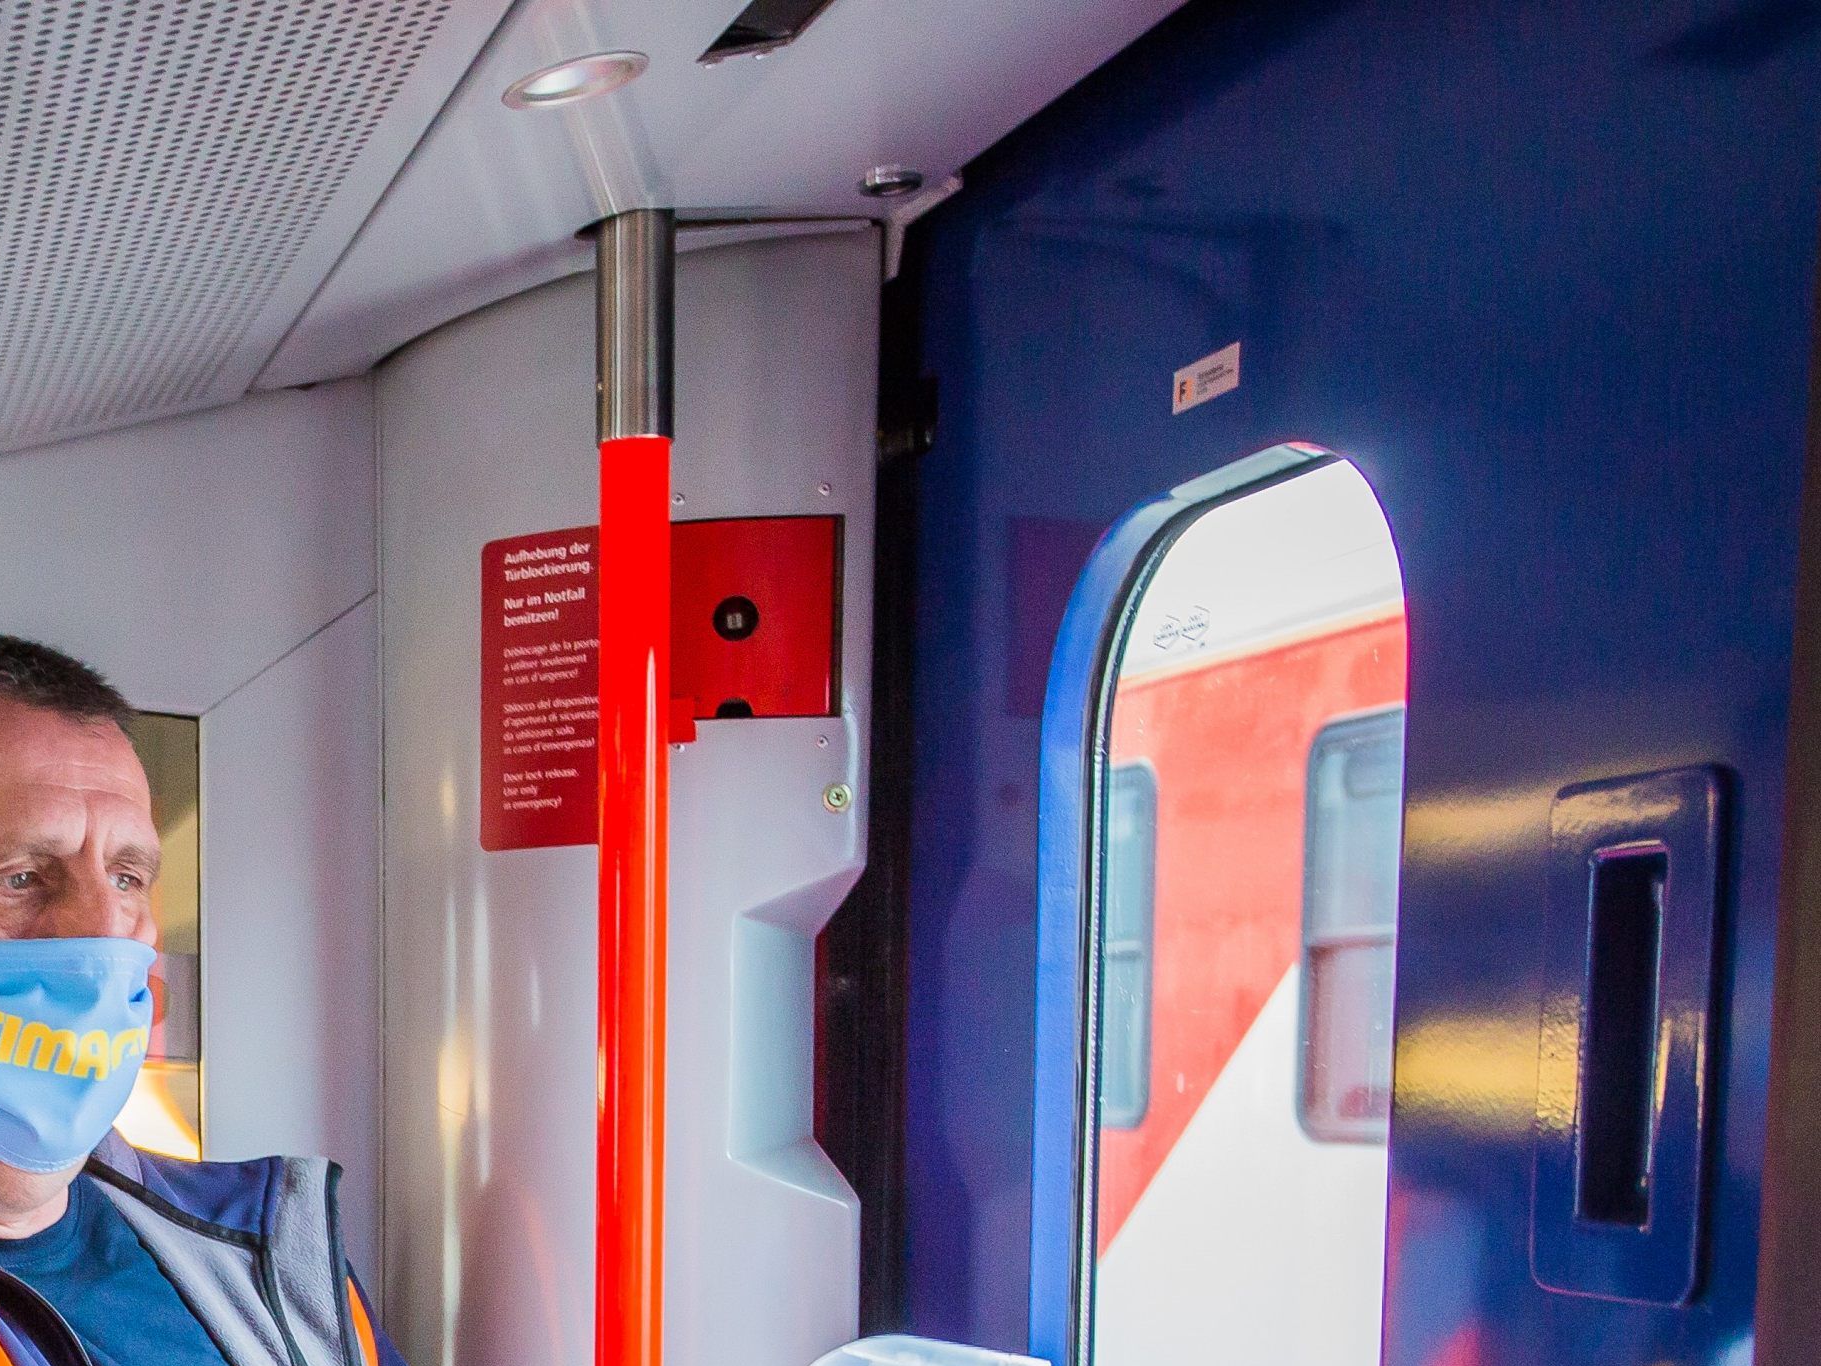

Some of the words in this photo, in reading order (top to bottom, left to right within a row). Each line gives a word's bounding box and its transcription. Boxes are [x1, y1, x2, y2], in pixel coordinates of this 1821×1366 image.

[504, 547, 567, 565] Aufhebung
[569, 542, 591, 555] der
[504, 598, 525, 610] Nur
[526, 594, 542, 607] im
[544, 587, 586, 604] Notfall
